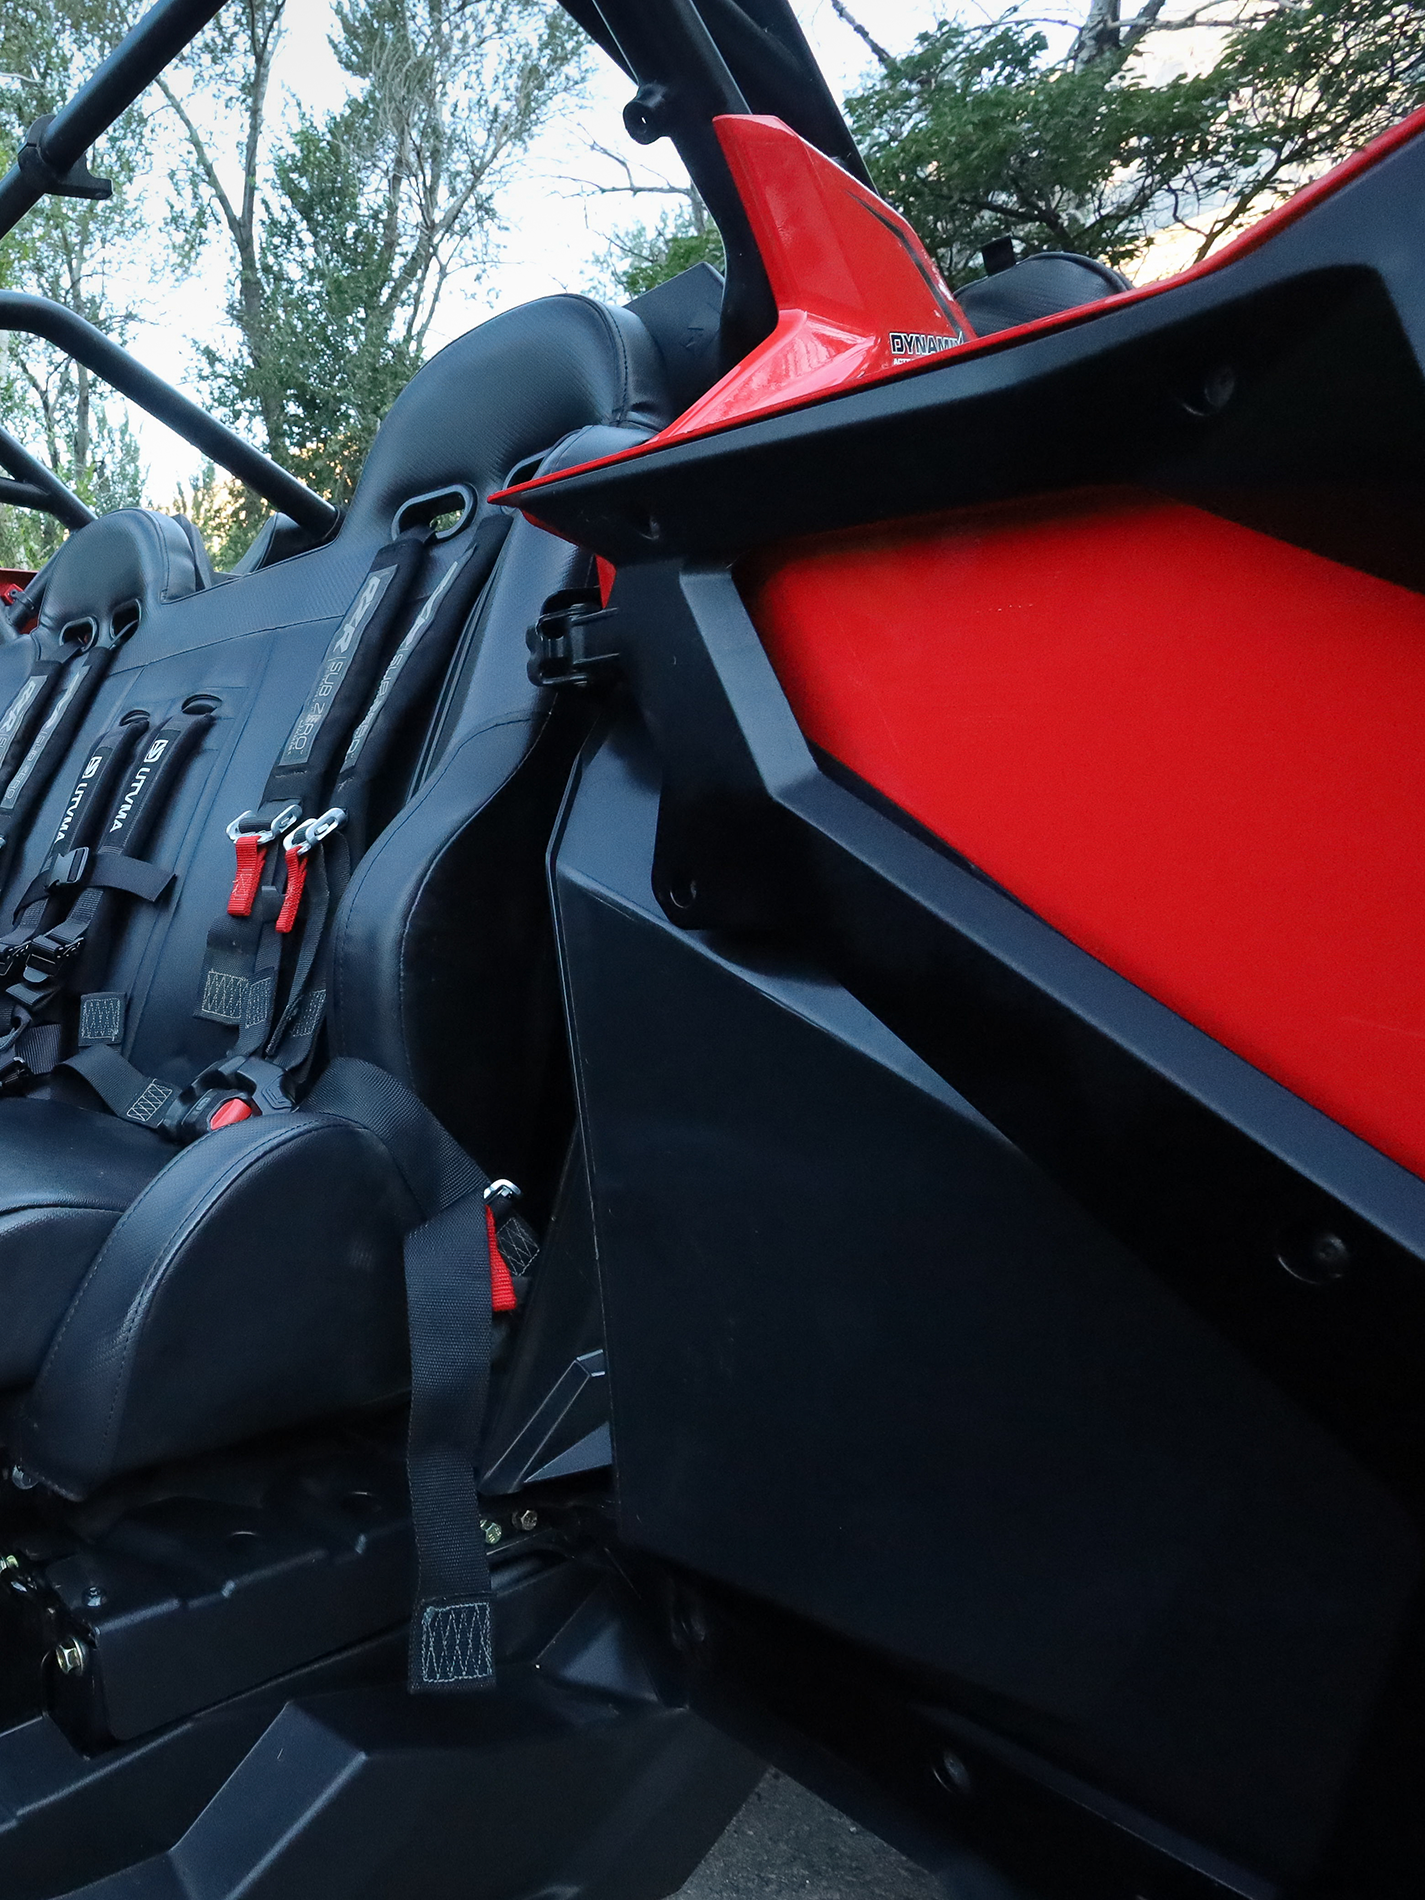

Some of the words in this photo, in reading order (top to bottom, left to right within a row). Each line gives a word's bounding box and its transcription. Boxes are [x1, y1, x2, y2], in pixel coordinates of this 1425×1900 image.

[333, 576, 381, 653] RZR
[0, 681, 36, 732] RZR
[318, 660, 344, 697] SUB
[295, 702, 326, 750] ZERO
[54, 782, 88, 844] UTVMA
[109, 767, 151, 833] UTVMA
